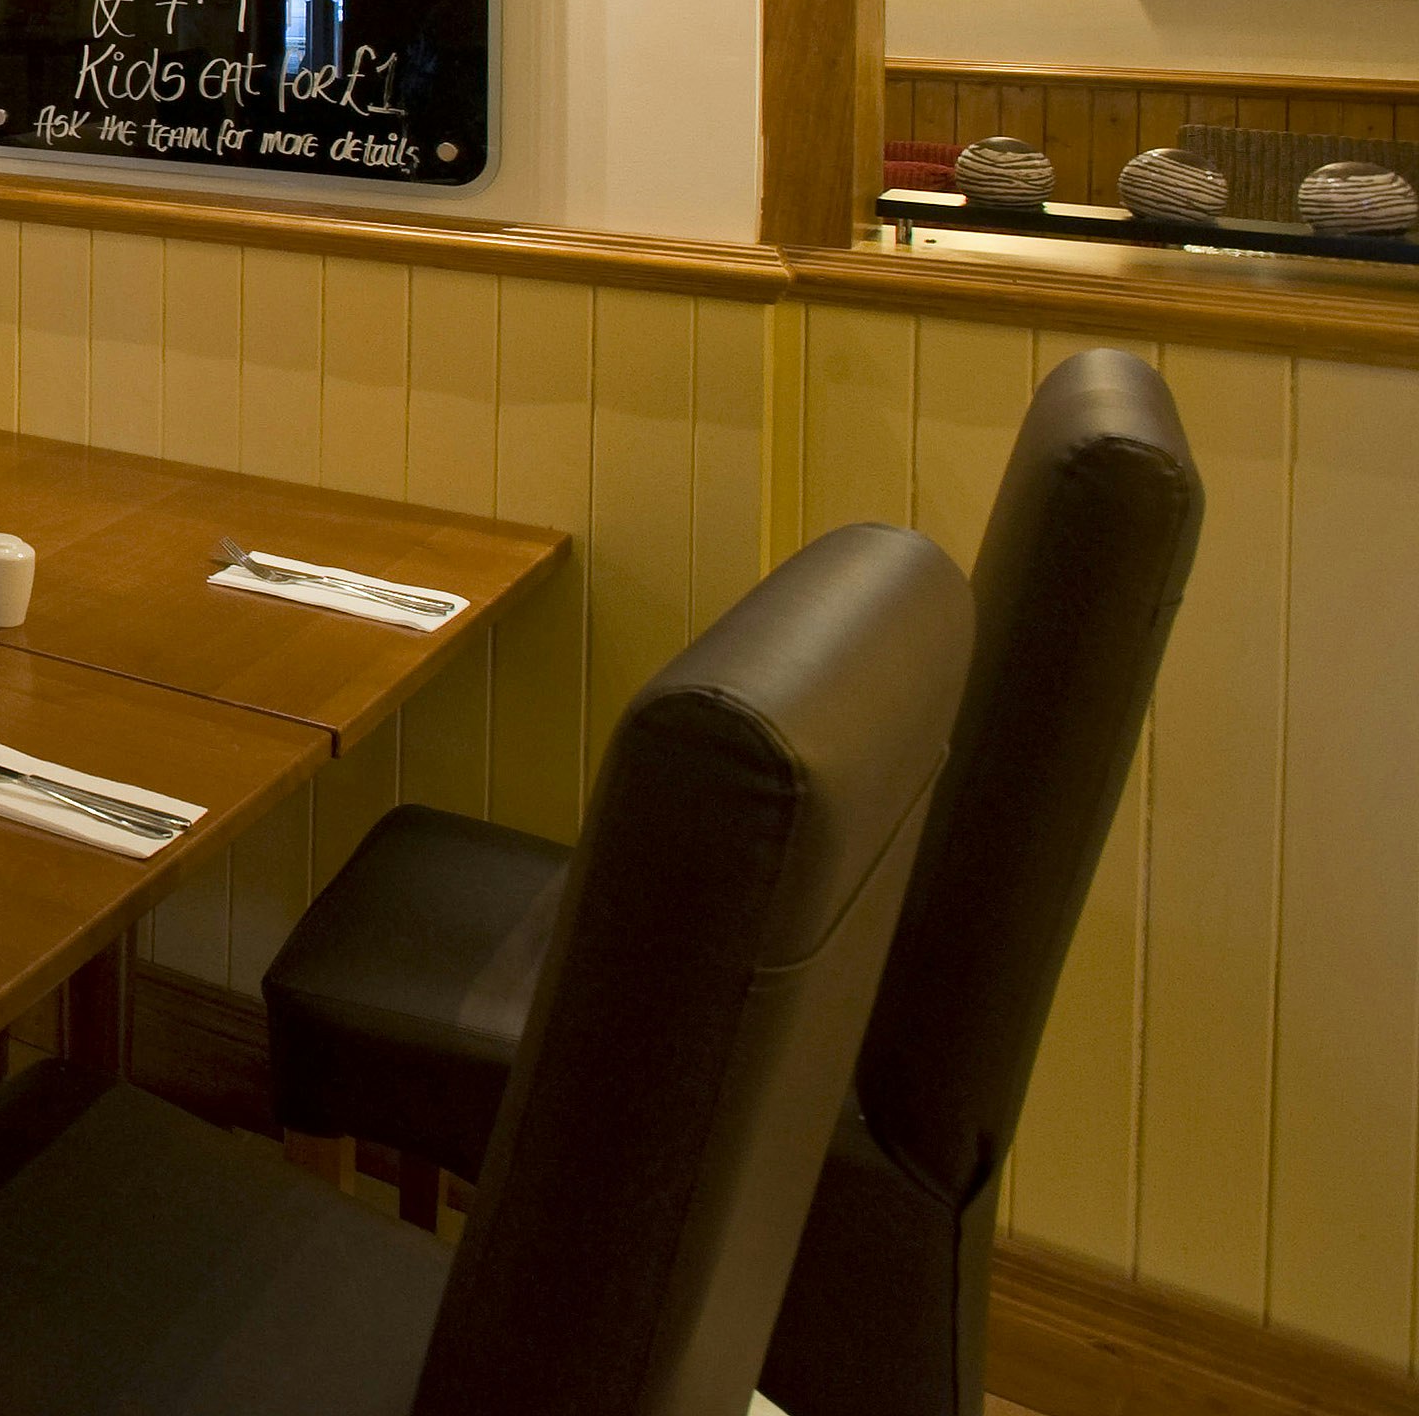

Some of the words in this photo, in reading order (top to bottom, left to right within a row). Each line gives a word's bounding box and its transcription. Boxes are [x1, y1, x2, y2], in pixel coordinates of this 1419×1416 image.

[74, 44, 186, 108] Kids
[217, 118, 253, 156] for
[330, 131, 420, 174] details
